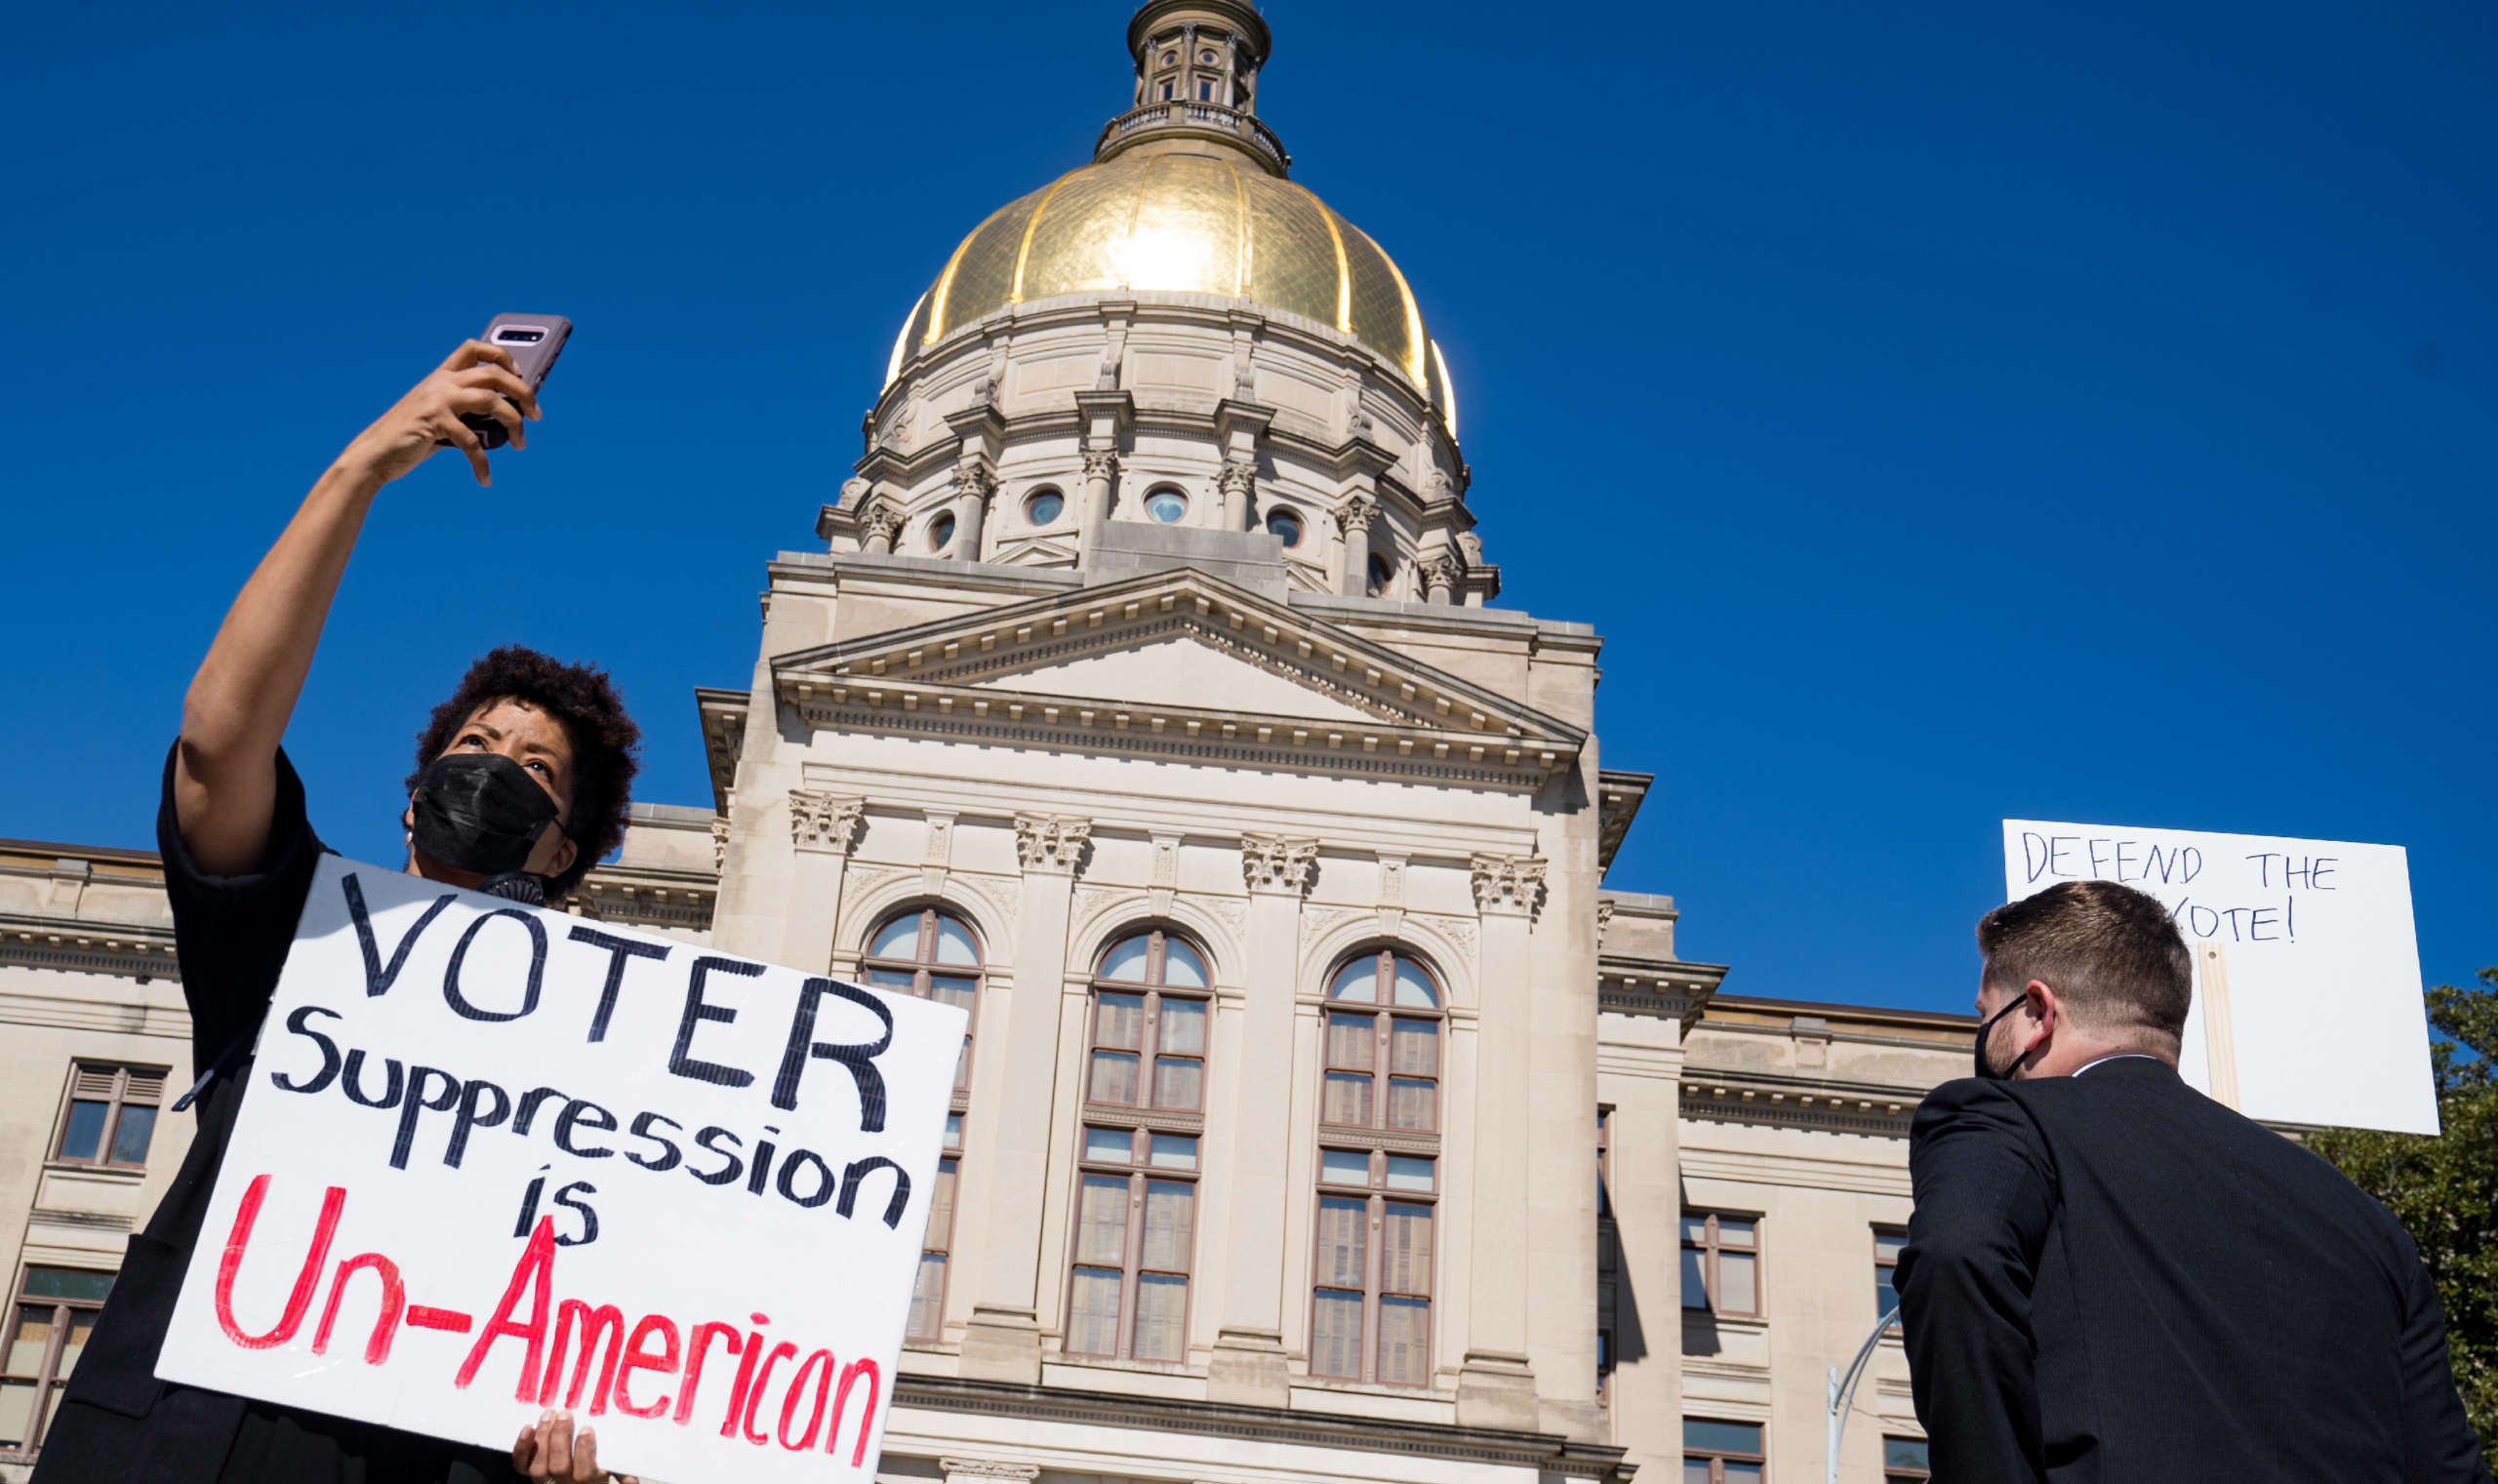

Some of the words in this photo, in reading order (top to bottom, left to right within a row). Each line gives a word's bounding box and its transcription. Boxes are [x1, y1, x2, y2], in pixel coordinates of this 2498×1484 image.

[2022, 832, 2202, 885] DEFEND
[2245, 853, 2339, 890] THE
[2172, 895, 2294, 943] OTE!
[342, 871, 895, 1133] VOTER
[271, 1006, 911, 1230] Suppression
[513, 1164, 599, 1247] is
[214, 1174, 880, 1469] Un-American
